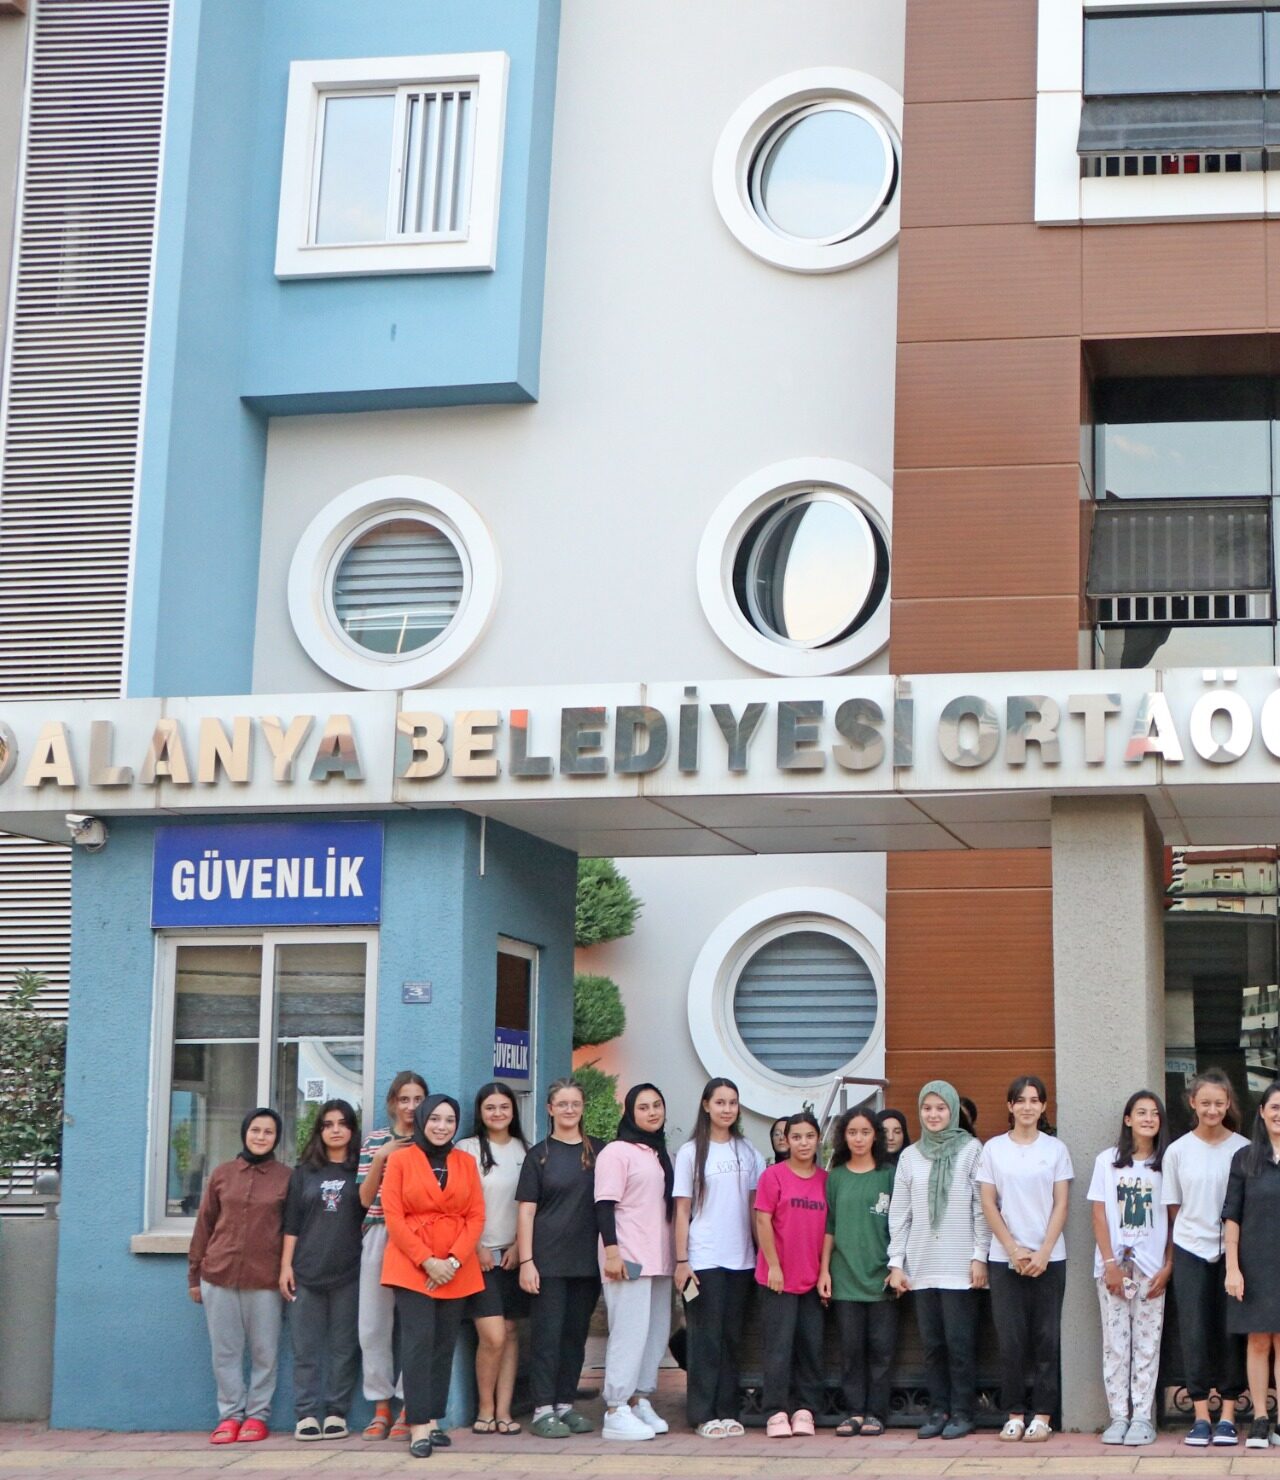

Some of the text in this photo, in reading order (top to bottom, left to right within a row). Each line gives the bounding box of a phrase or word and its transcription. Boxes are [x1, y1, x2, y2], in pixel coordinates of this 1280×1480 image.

[23, 714, 366, 788] ALANYA
[400, 681, 915, 779] BELEDİYESİ
[171, 847, 365, 901] GÜVENLİK
[493, 1035, 528, 1071] ÜVENLİK
